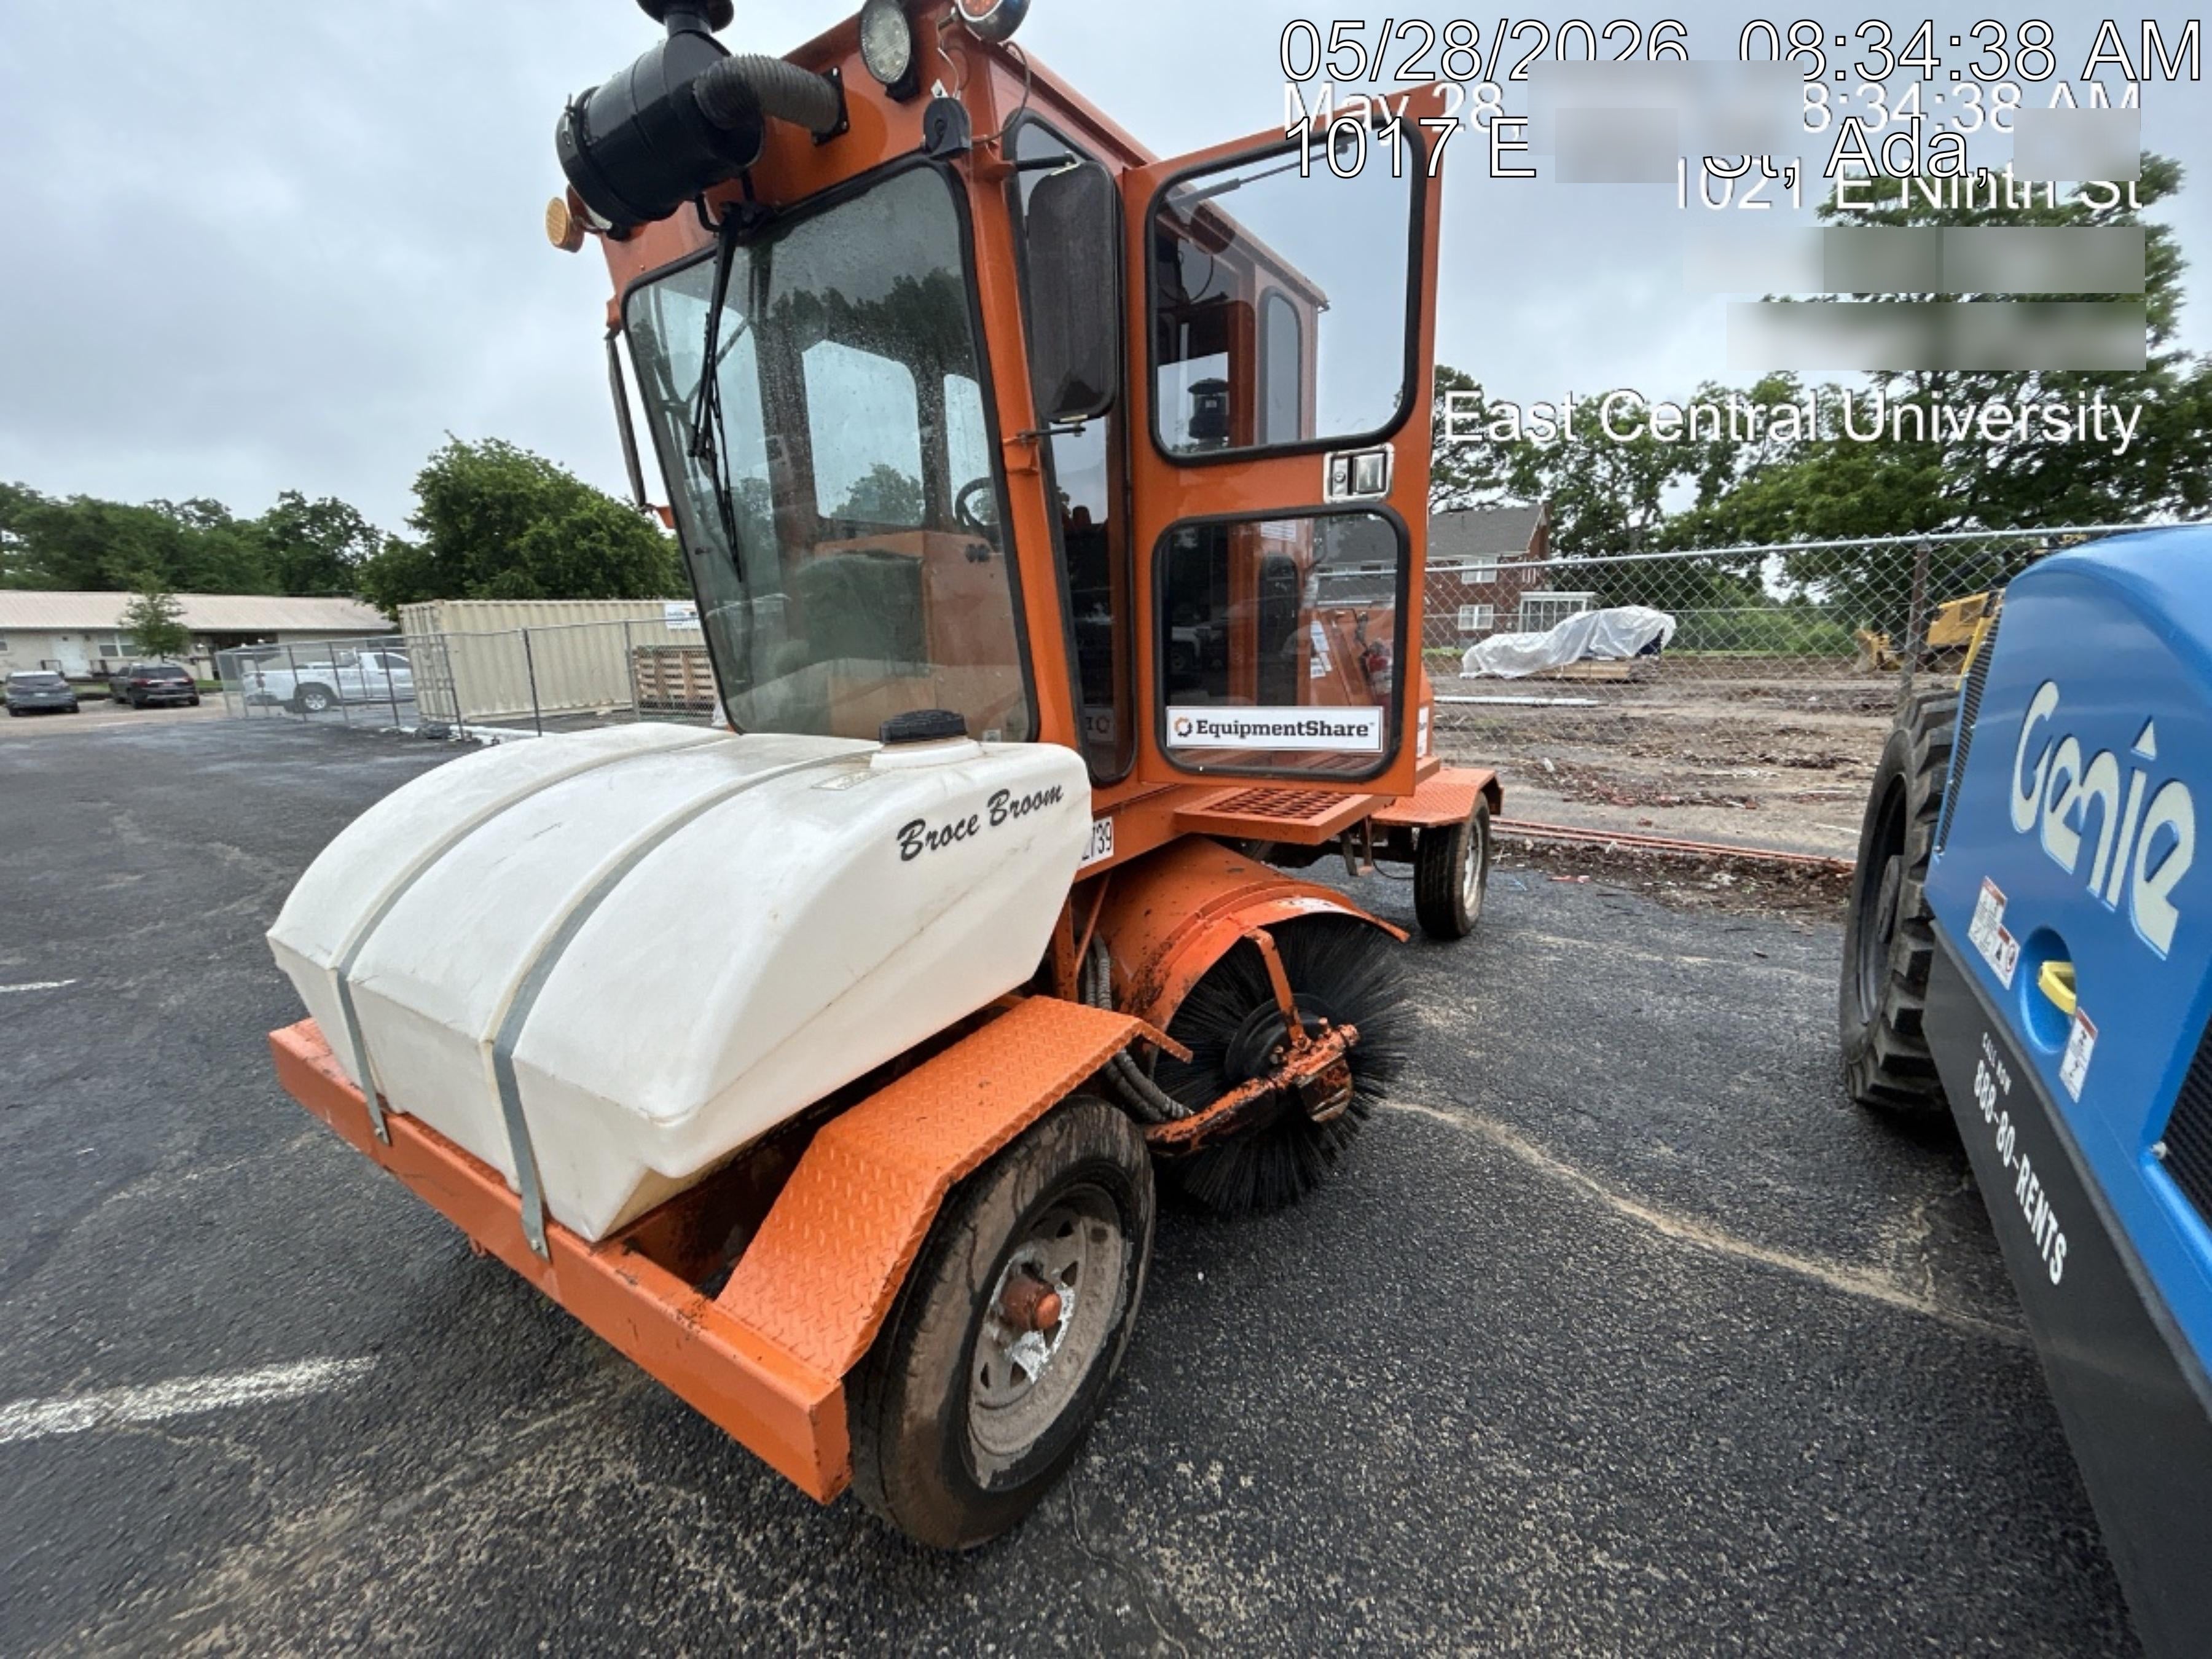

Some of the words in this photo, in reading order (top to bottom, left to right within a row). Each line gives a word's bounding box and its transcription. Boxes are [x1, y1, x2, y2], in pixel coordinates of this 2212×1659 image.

[1196, 718, 1369, 739] EquipmentShare
[896, 818, 981, 861] Broce
[987, 785, 1064, 826] Broom
[2010, 678, 2195, 960] Genie
[1974, 1059, 2067, 1285] 888-80-RENTS
